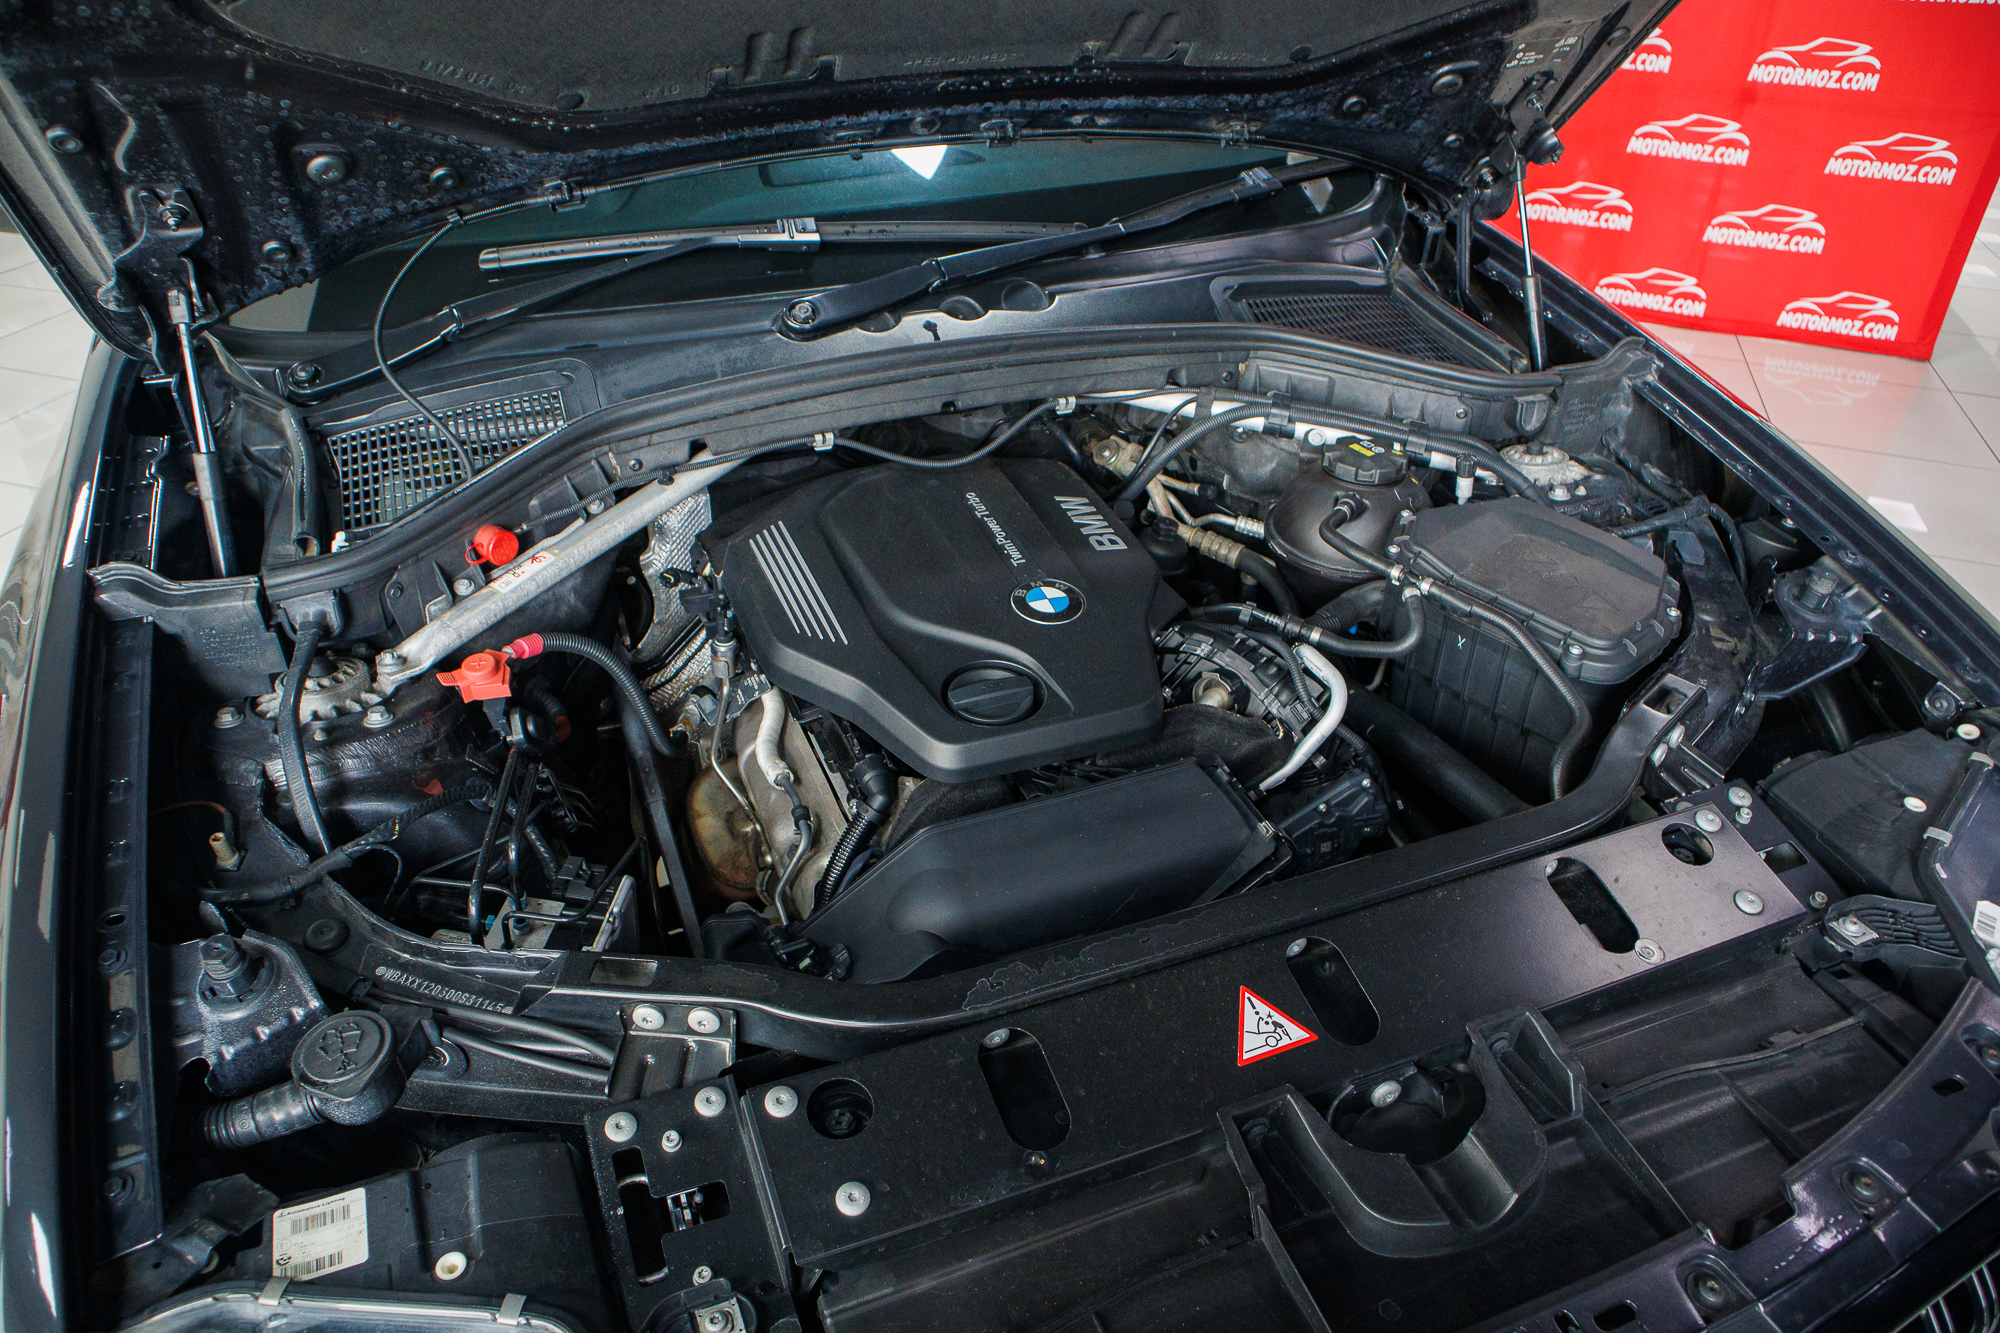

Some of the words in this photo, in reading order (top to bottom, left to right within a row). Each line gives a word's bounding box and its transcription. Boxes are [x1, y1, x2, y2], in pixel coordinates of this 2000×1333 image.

[1747, 63, 1880, 92] MOTORMOZ.COM
[1626, 136, 1750, 167] MOTORMOZ.COM
[1824, 157, 1957, 186] MOTORMOZ.COM
[1702, 225, 1826, 255] MOTORMOZ.COM
[1776, 310, 1899, 342] MOTORMOZ.COM
[966, 492, 990, 518] Turbo
[1054, 495, 1128, 551] BMW
[1014, 580, 1069, 598] BMW
